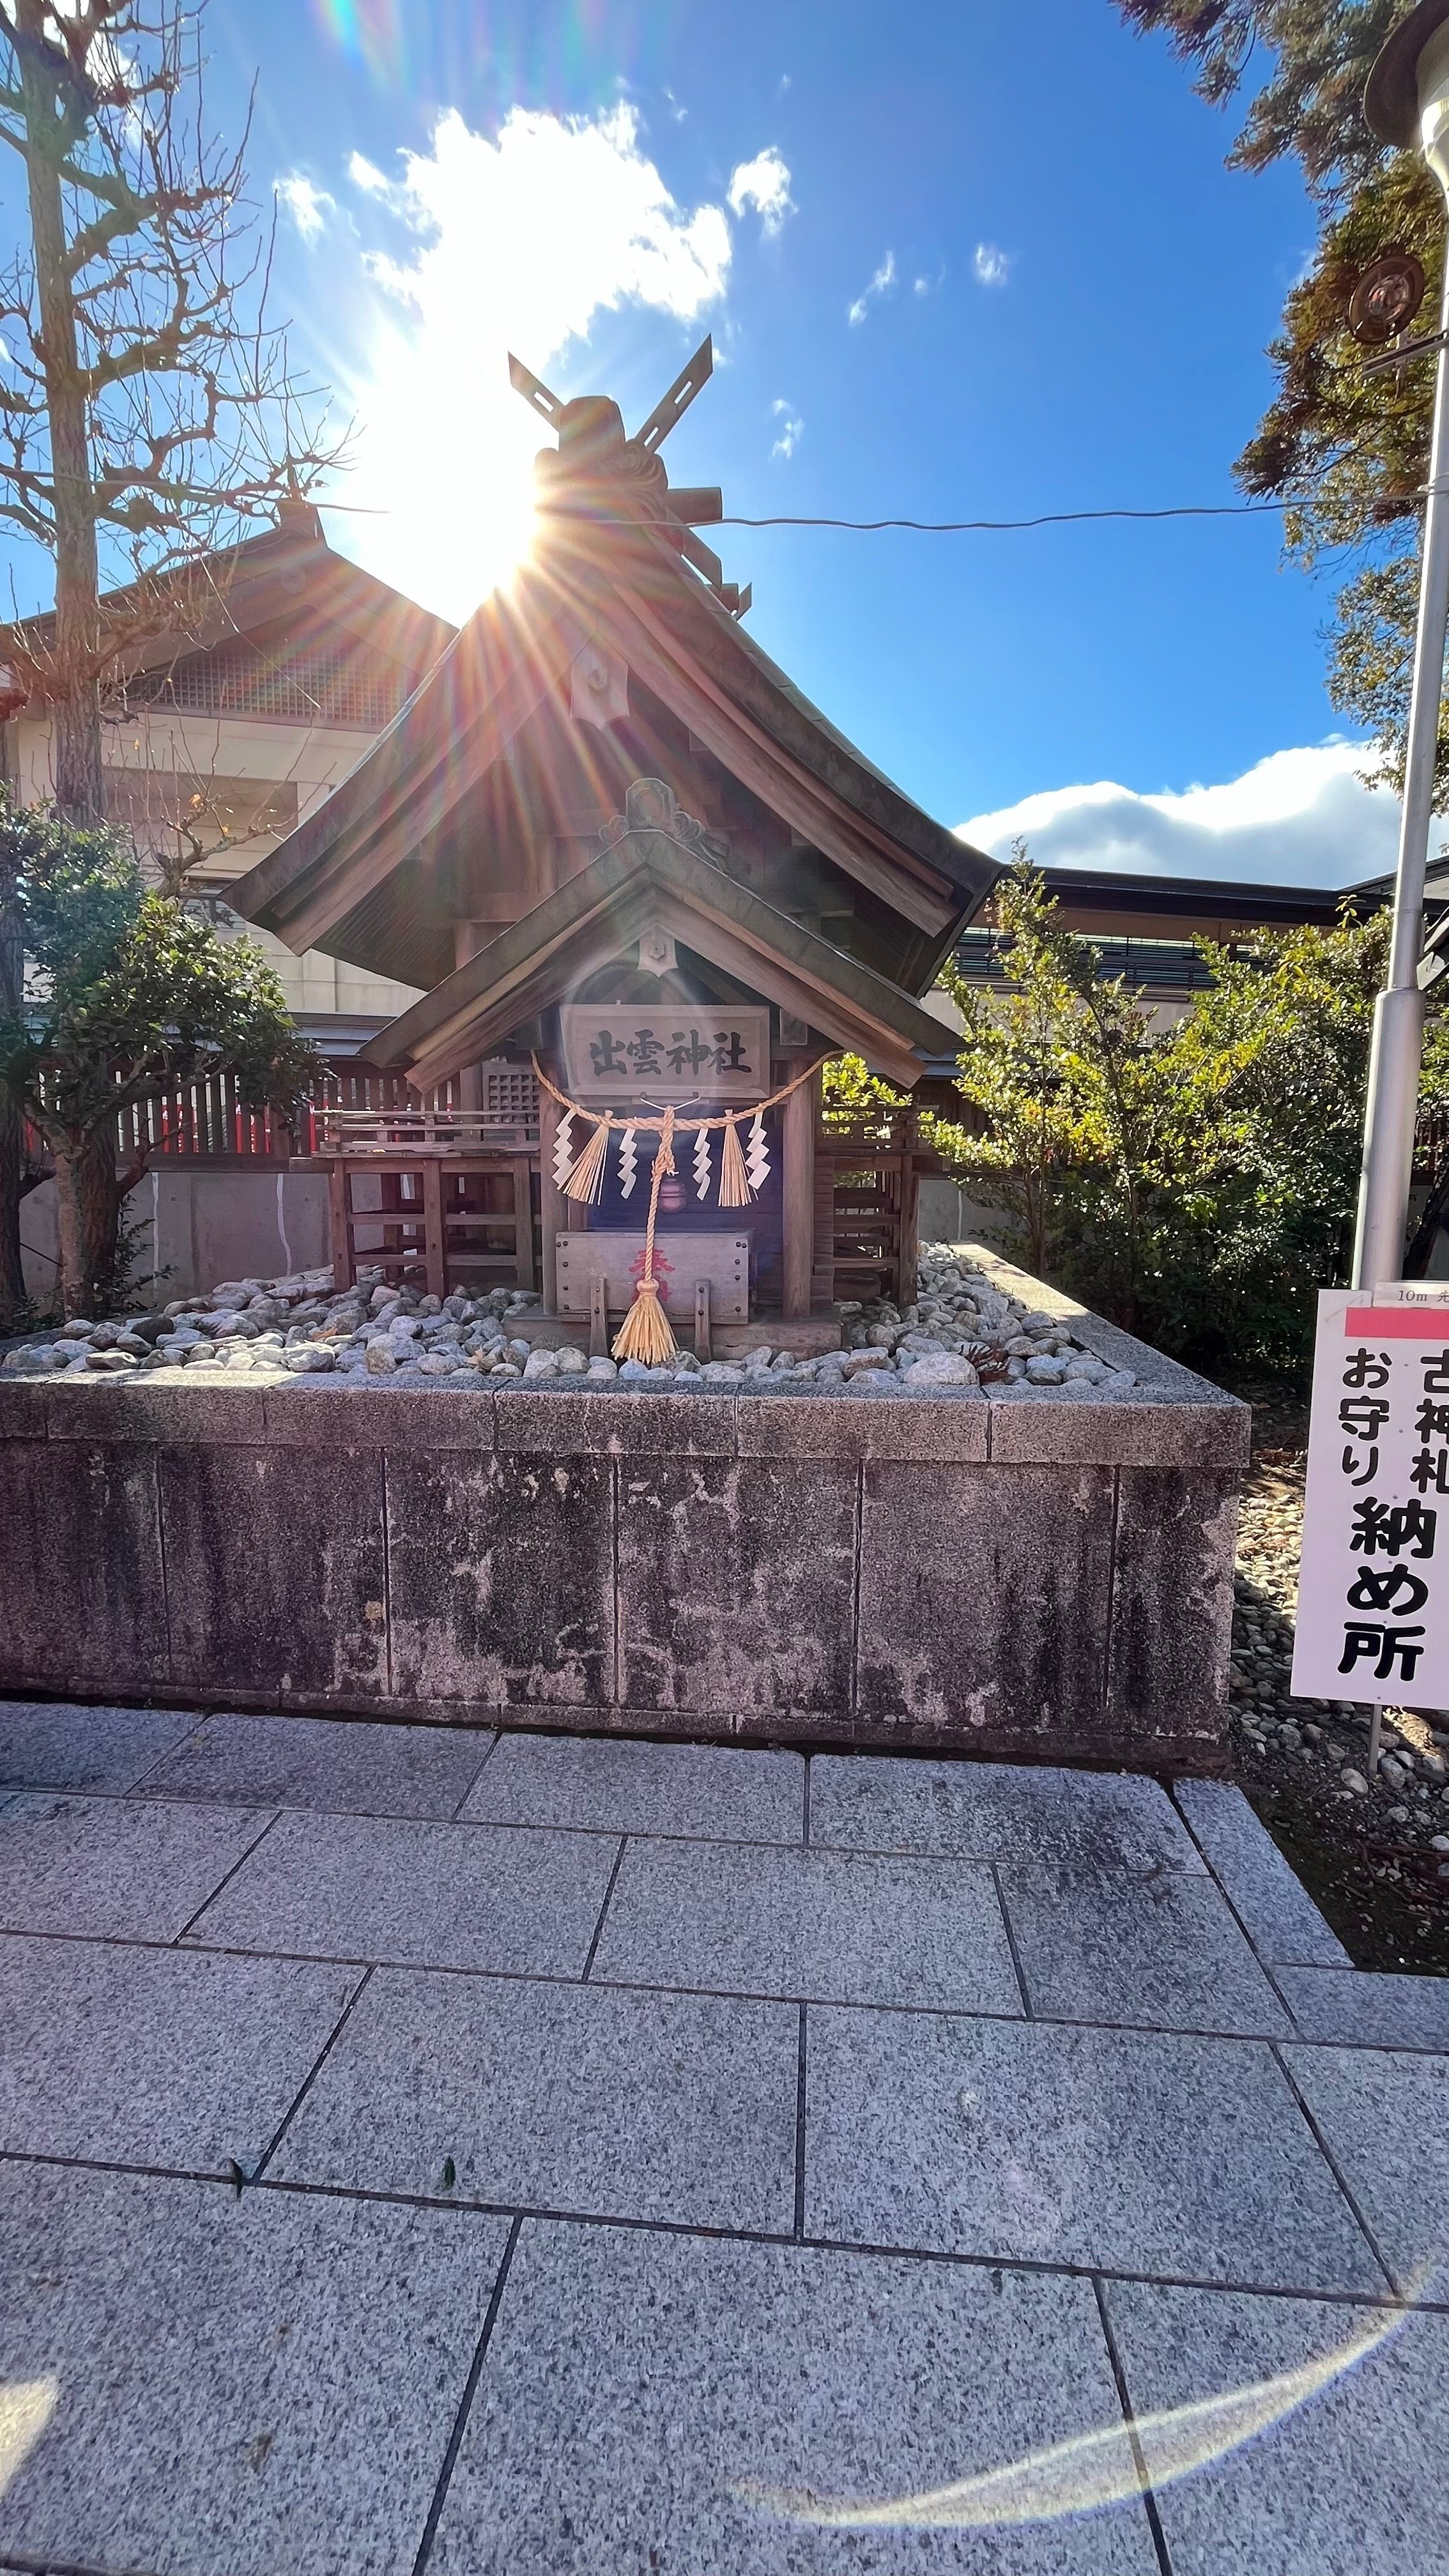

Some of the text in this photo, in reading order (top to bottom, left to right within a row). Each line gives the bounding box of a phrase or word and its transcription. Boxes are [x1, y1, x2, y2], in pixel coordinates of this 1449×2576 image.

[589, 1029, 752, 1076] 出雲神社
[629, 1248, 676, 1302] 奉
[1398, 1290, 1427, 1301] 10m
